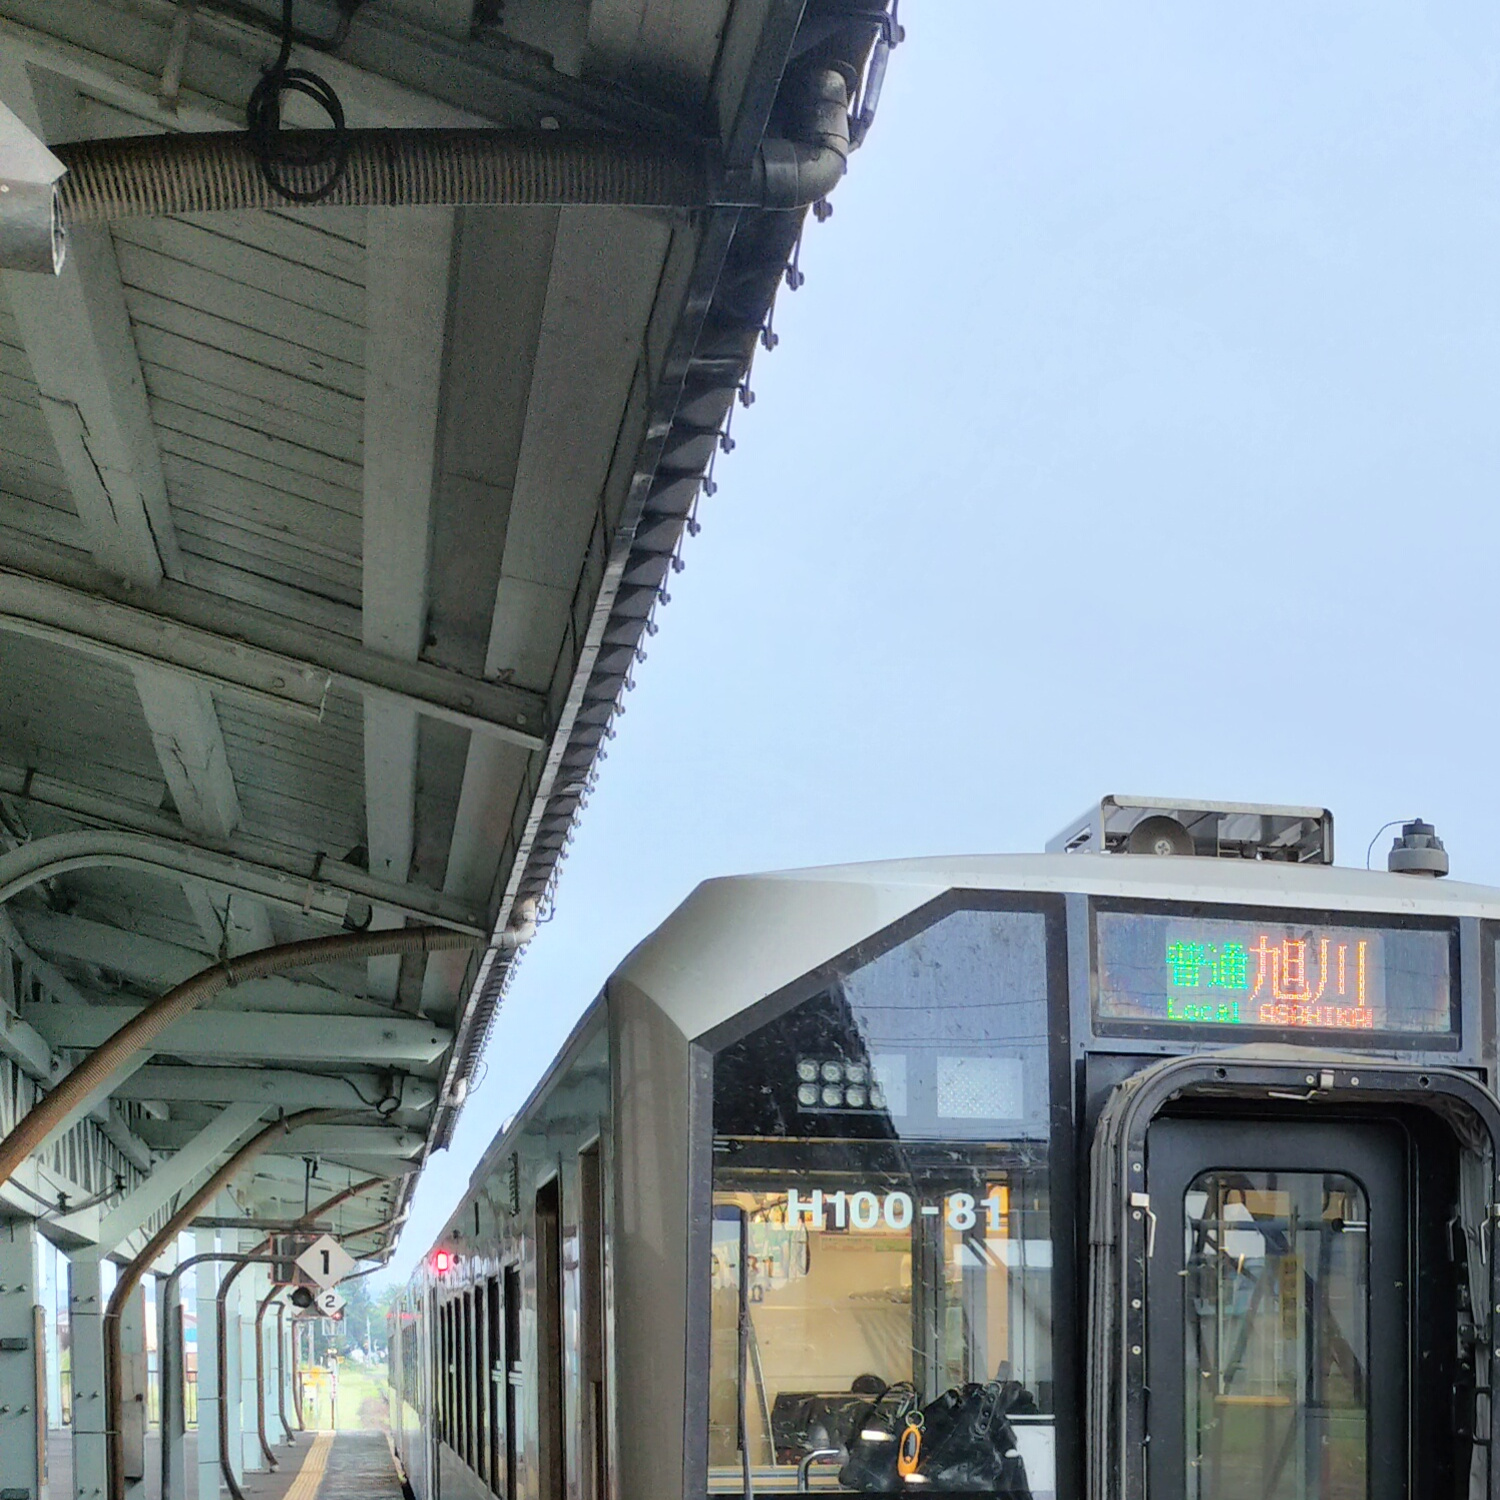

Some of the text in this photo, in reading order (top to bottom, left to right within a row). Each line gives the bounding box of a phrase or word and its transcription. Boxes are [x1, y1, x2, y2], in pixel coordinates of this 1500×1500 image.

[1165, 935, 1367, 1006] 普通 旭川
[1167, 997, 1240, 1024] Local
[787, 1189, 1002, 1231] H100-81
[320, 1249, 330, 1275] 1
[325, 1294, 336, 1308] 2
